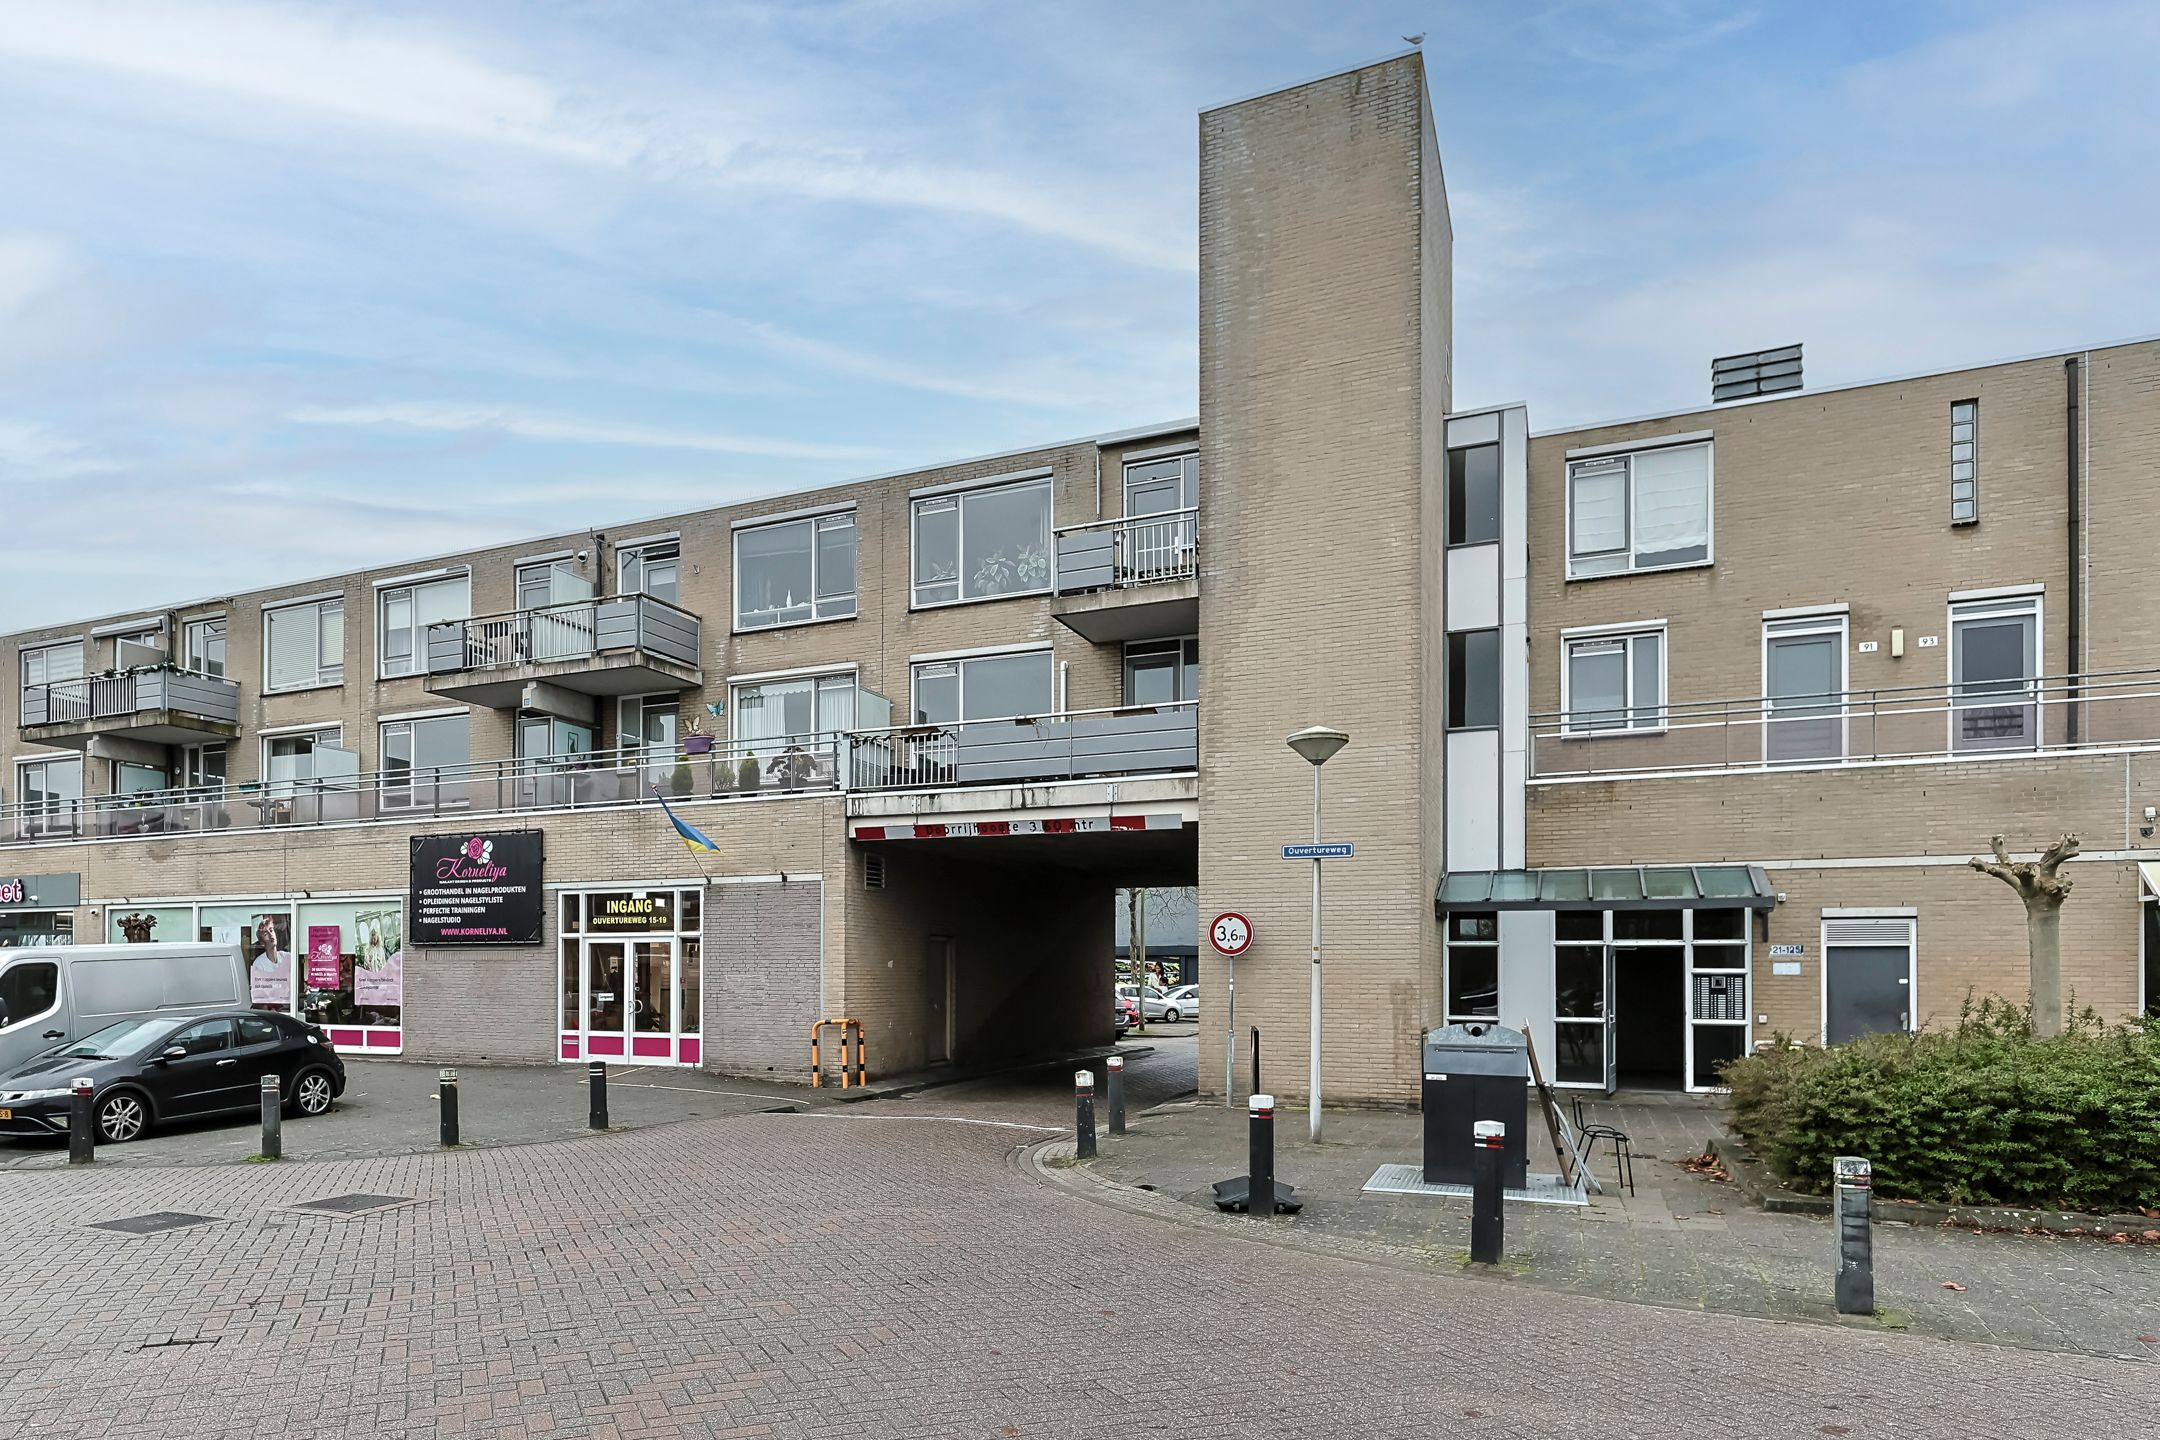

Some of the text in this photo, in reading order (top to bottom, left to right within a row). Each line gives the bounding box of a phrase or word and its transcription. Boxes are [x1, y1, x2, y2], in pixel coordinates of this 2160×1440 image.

[1922, 637, 1934, 645] 93
[1864, 643, 1873, 651] 91
[1288, 846, 1347, 855] Ouvertureweg
[436, 857, 508, 883] Korneliya
[0, 879, 22, 902] et
[423, 886, 526, 896] GROOTHANDEL IN NAGELPRODUKTEN
[423, 896, 503, 905] OPLEIDINGEN NAGELSTYLISTE
[423, 906, 486, 915] PERFECTIE TRAININGEN
[606, 899, 653, 914] INGANG
[423, 916, 461, 924] NAGELSTUDIO
[592, 916, 667, 925] OUVERTUREWEG 15-19
[440, 927, 508, 936] WWW.KORNELIYA.NL
